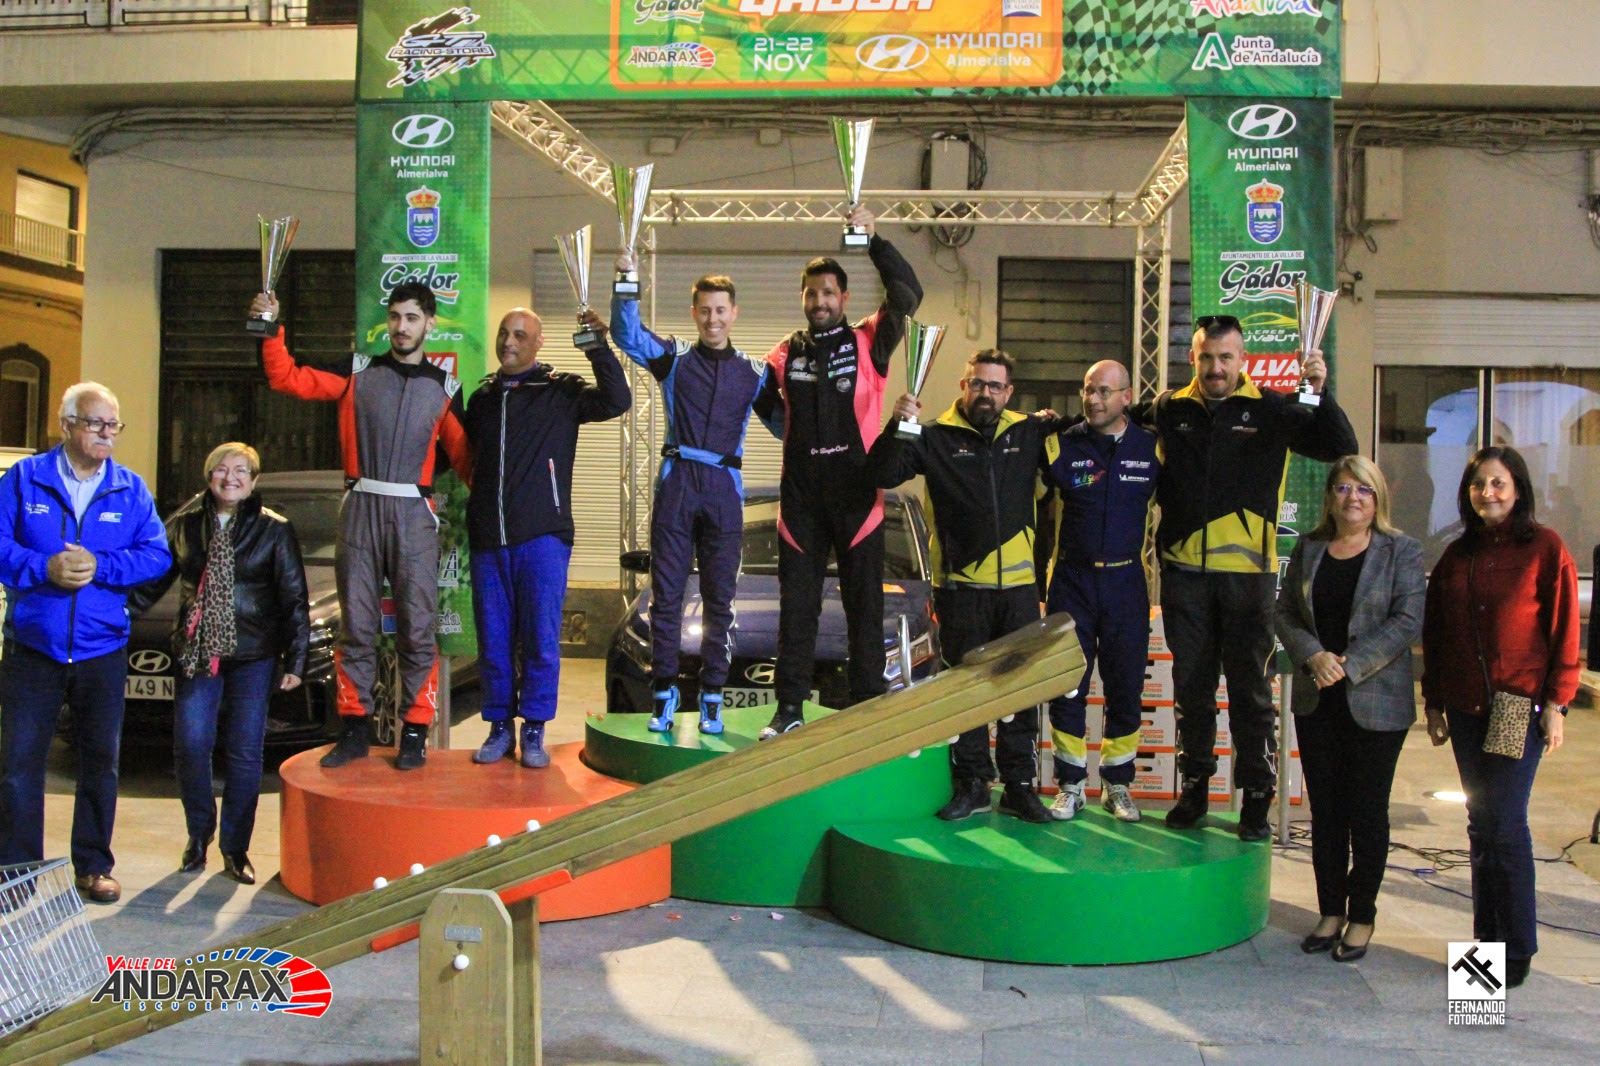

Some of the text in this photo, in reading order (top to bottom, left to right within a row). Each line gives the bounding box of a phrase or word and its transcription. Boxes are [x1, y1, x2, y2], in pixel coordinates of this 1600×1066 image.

[753, 37, 813, 52] 21-22
[935, 33, 1042, 49] HYUNDAI
[1233, 38, 1272, 49] Junta
[393, 47, 489, 56] RACING STORE
[627, 50, 699, 64] ANDARAX
[1233, 49, 1319, 63] de Andalucía
[753, 54, 813, 72] NOV
[946, 54, 1031, 68] Almerialva
[1228, 147, 1299, 160] HYUNDAI
[390, 155, 456, 167] HYUNDAI
[1235, 162, 1291, 172] Almerialva
[396, 169, 449, 179] Almerialva
[1274, 379, 1298, 388] CAR
[723, 690, 769, 709] 5281
